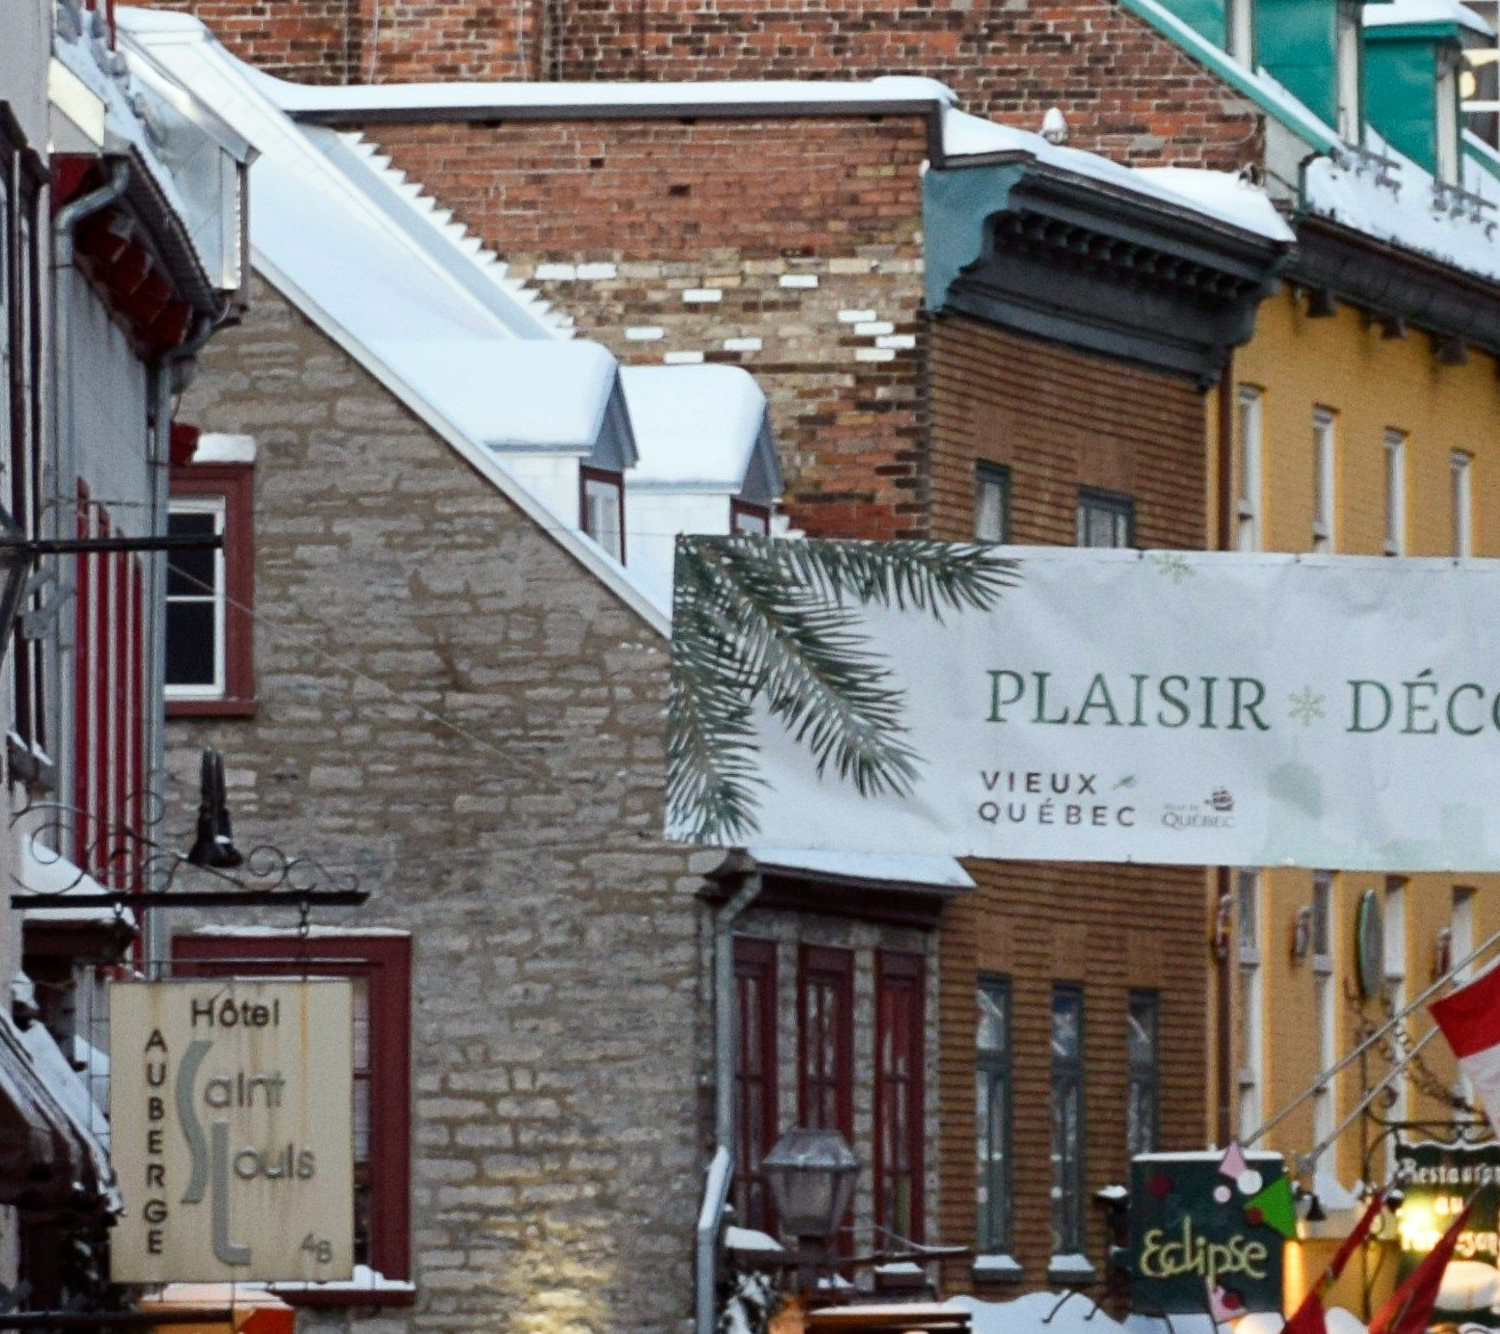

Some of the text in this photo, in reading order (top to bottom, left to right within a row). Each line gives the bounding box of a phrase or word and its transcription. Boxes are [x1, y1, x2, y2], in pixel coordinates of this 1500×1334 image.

[985, 669, 1271, 732] PLAISIR
[981, 770, 1097, 795] VIEUX
[978, 798, 1136, 827] QUÉBEC
[190, 997, 280, 1028] Hôtel
[144, 1028, 169, 1255] AUBERGE
[301, 1232, 334, 1264] 48
